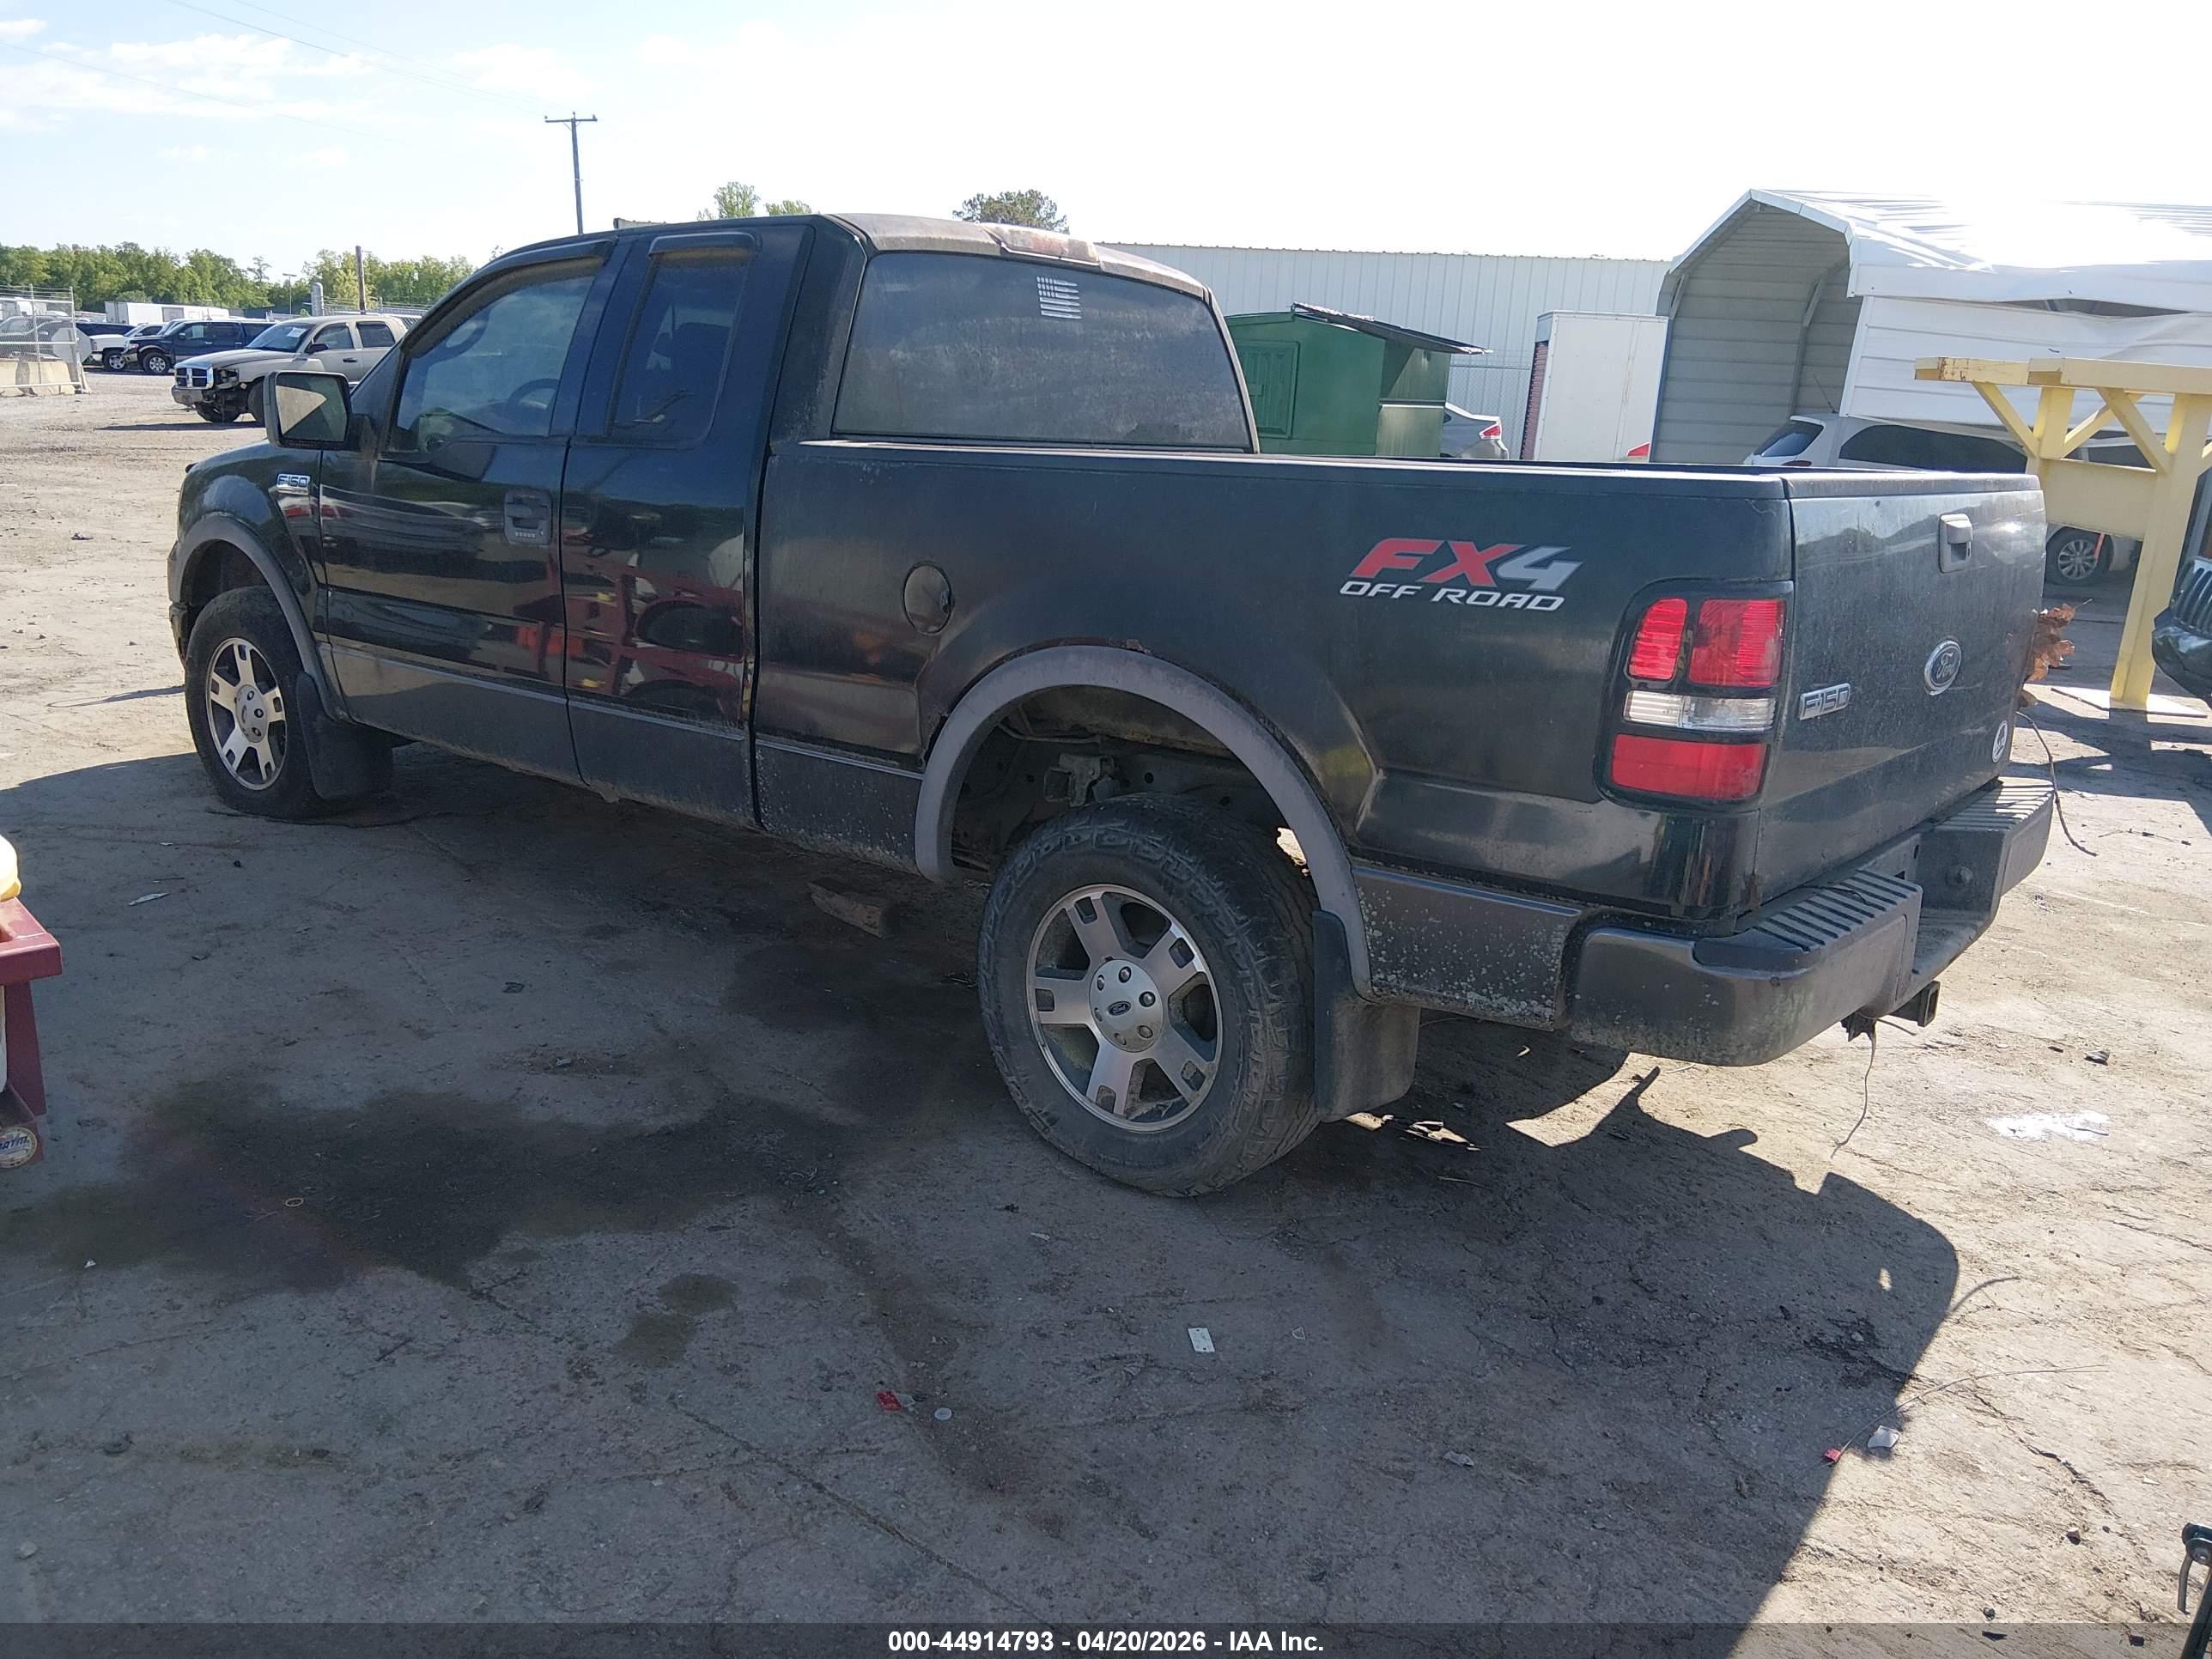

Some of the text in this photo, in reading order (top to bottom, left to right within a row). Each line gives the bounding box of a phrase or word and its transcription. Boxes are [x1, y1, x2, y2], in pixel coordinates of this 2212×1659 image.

[1348, 538, 1585, 592] FX4
[1339, 580, 1565, 611] OFF ROAD
